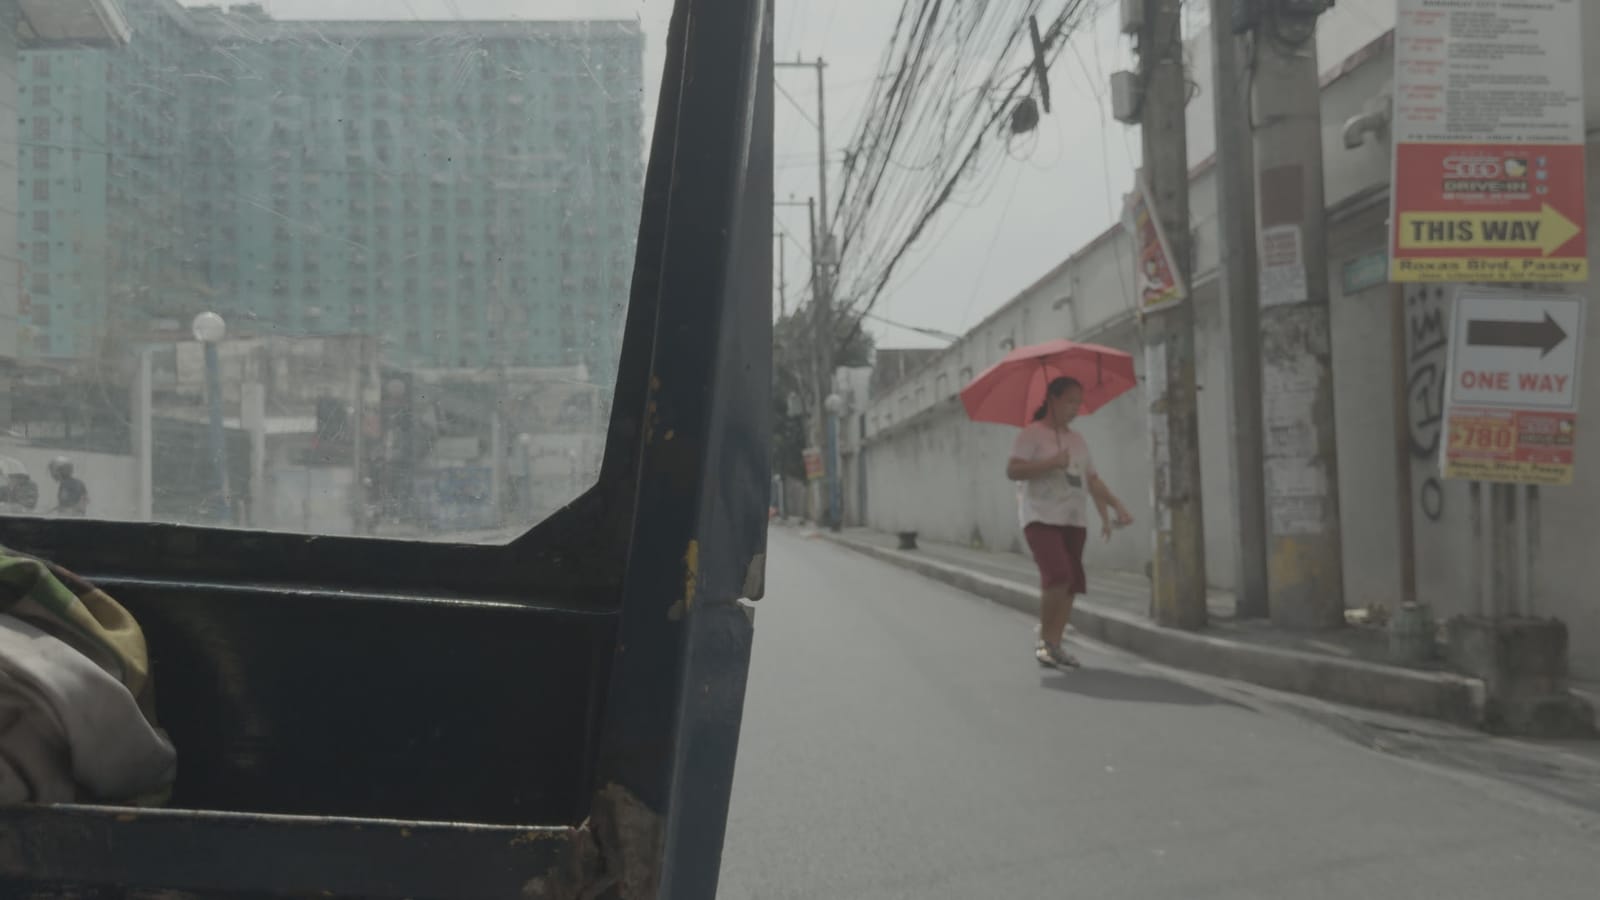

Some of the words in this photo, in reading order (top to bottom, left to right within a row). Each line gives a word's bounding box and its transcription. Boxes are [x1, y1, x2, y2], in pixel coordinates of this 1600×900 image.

[1443, 181, 1528, 192] DRIVE-IN
[1410, 220, 1473, 241] THIS
[1482, 221, 1541, 241] WAY
[1522, 261, 1582, 273] Pasay
[1460, 370, 1510, 390] ONE
[1518, 373, 1569, 393] WAY
